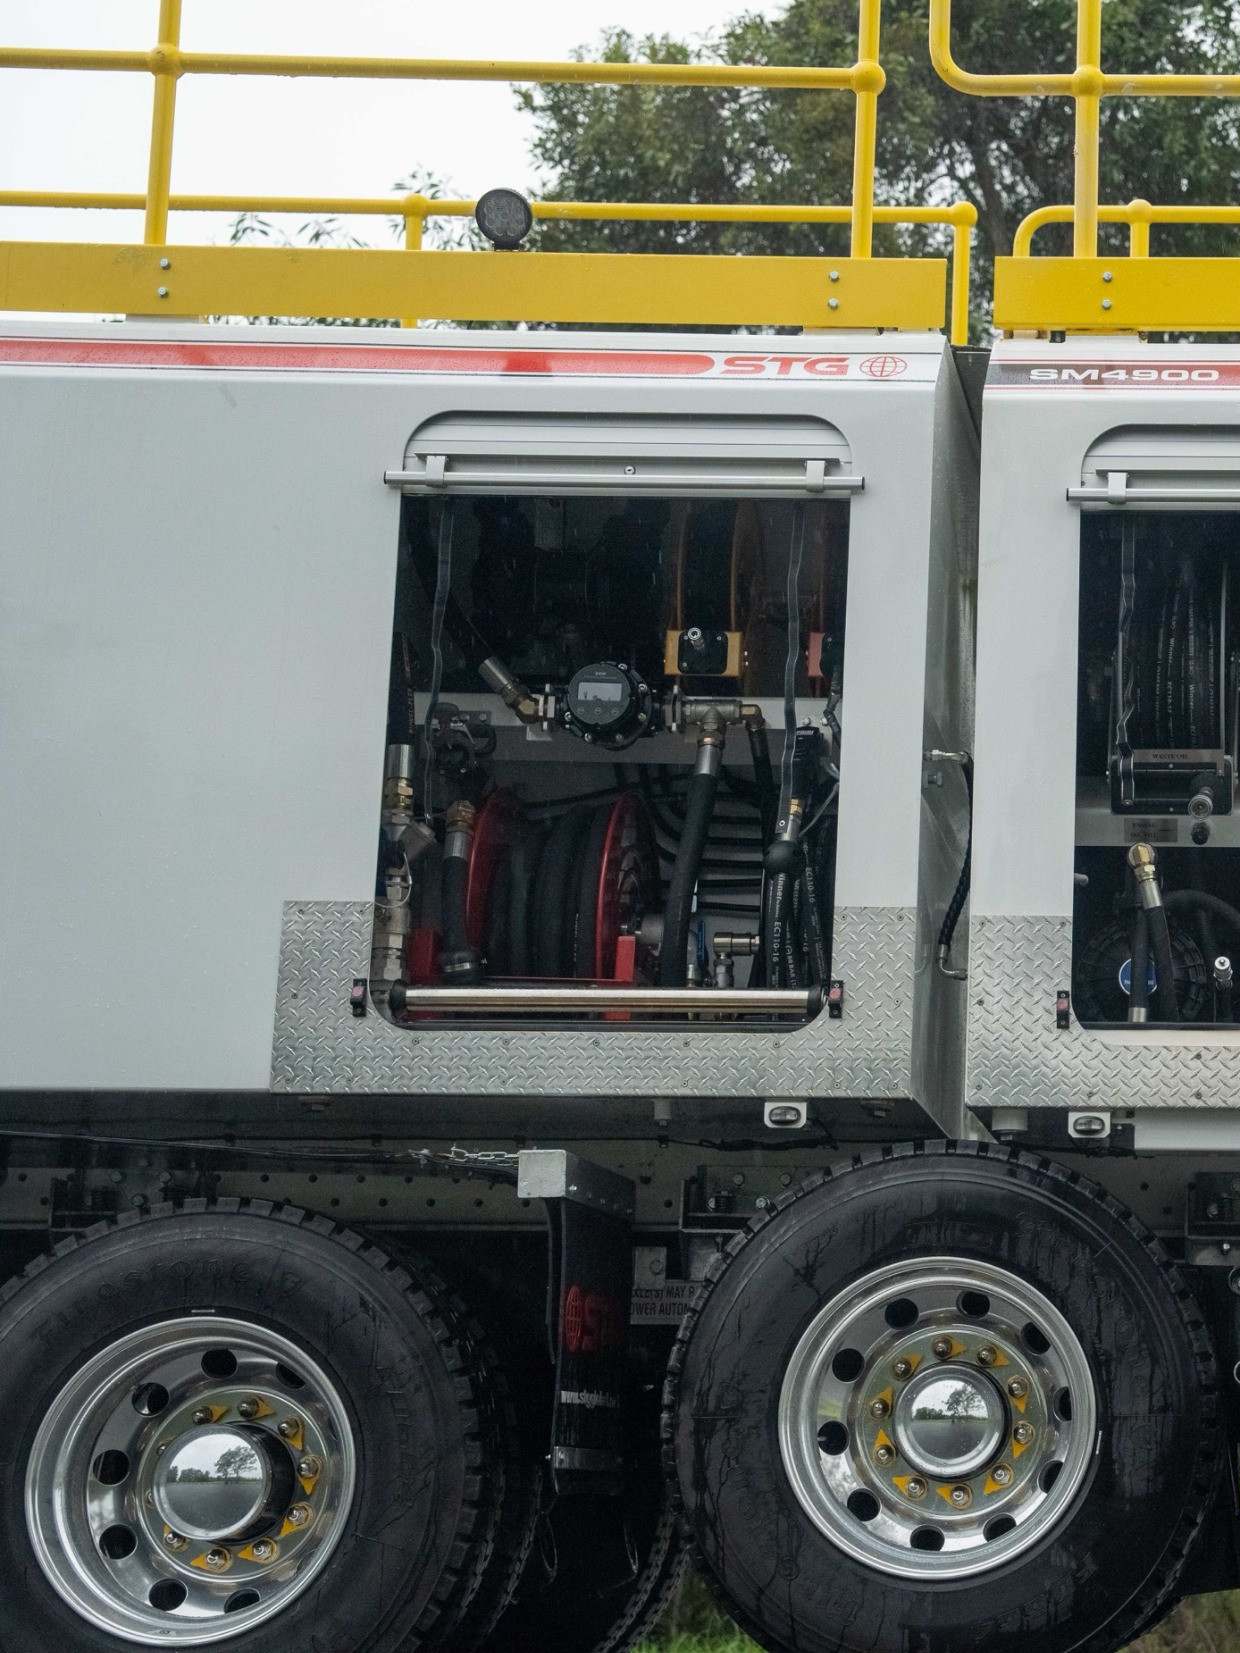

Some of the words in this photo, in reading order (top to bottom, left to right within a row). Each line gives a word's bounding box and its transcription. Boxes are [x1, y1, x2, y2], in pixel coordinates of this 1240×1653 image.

[719, 356, 850, 376] STG
[1029, 368, 1220, 381] SM4900
[771, 921, 782, 962] EC110-16
[632, 1289, 664, 1300] XLE(S)
[666, 1286, 686, 1298] MAY
[630, 1302, 656, 1315] OWER
